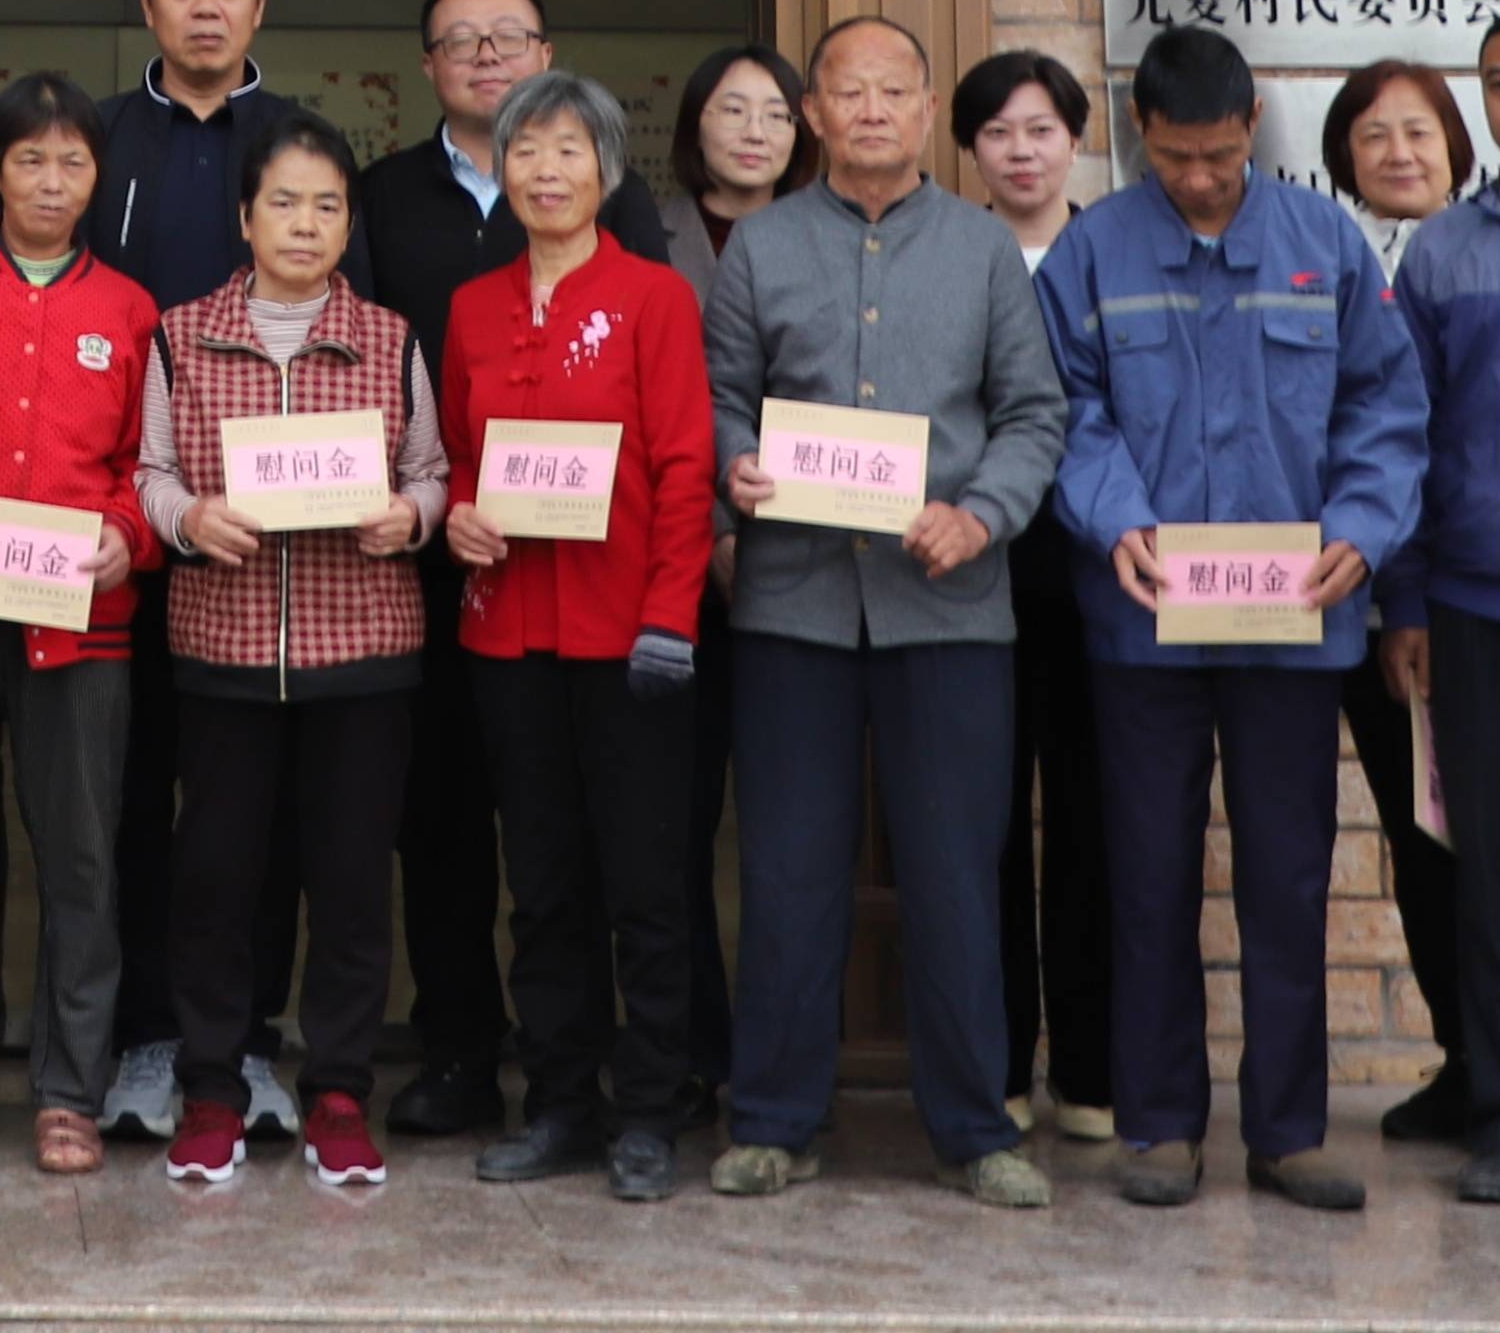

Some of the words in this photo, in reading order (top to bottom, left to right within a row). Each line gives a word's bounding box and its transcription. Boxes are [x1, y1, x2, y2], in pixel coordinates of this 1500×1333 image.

[254, 446, 358, 482] 慰问金
[502, 452, 588, 490] 慰问金
[791, 441, 896, 486] 慰问金
[1186, 561, 1290, 596] 慰问金
